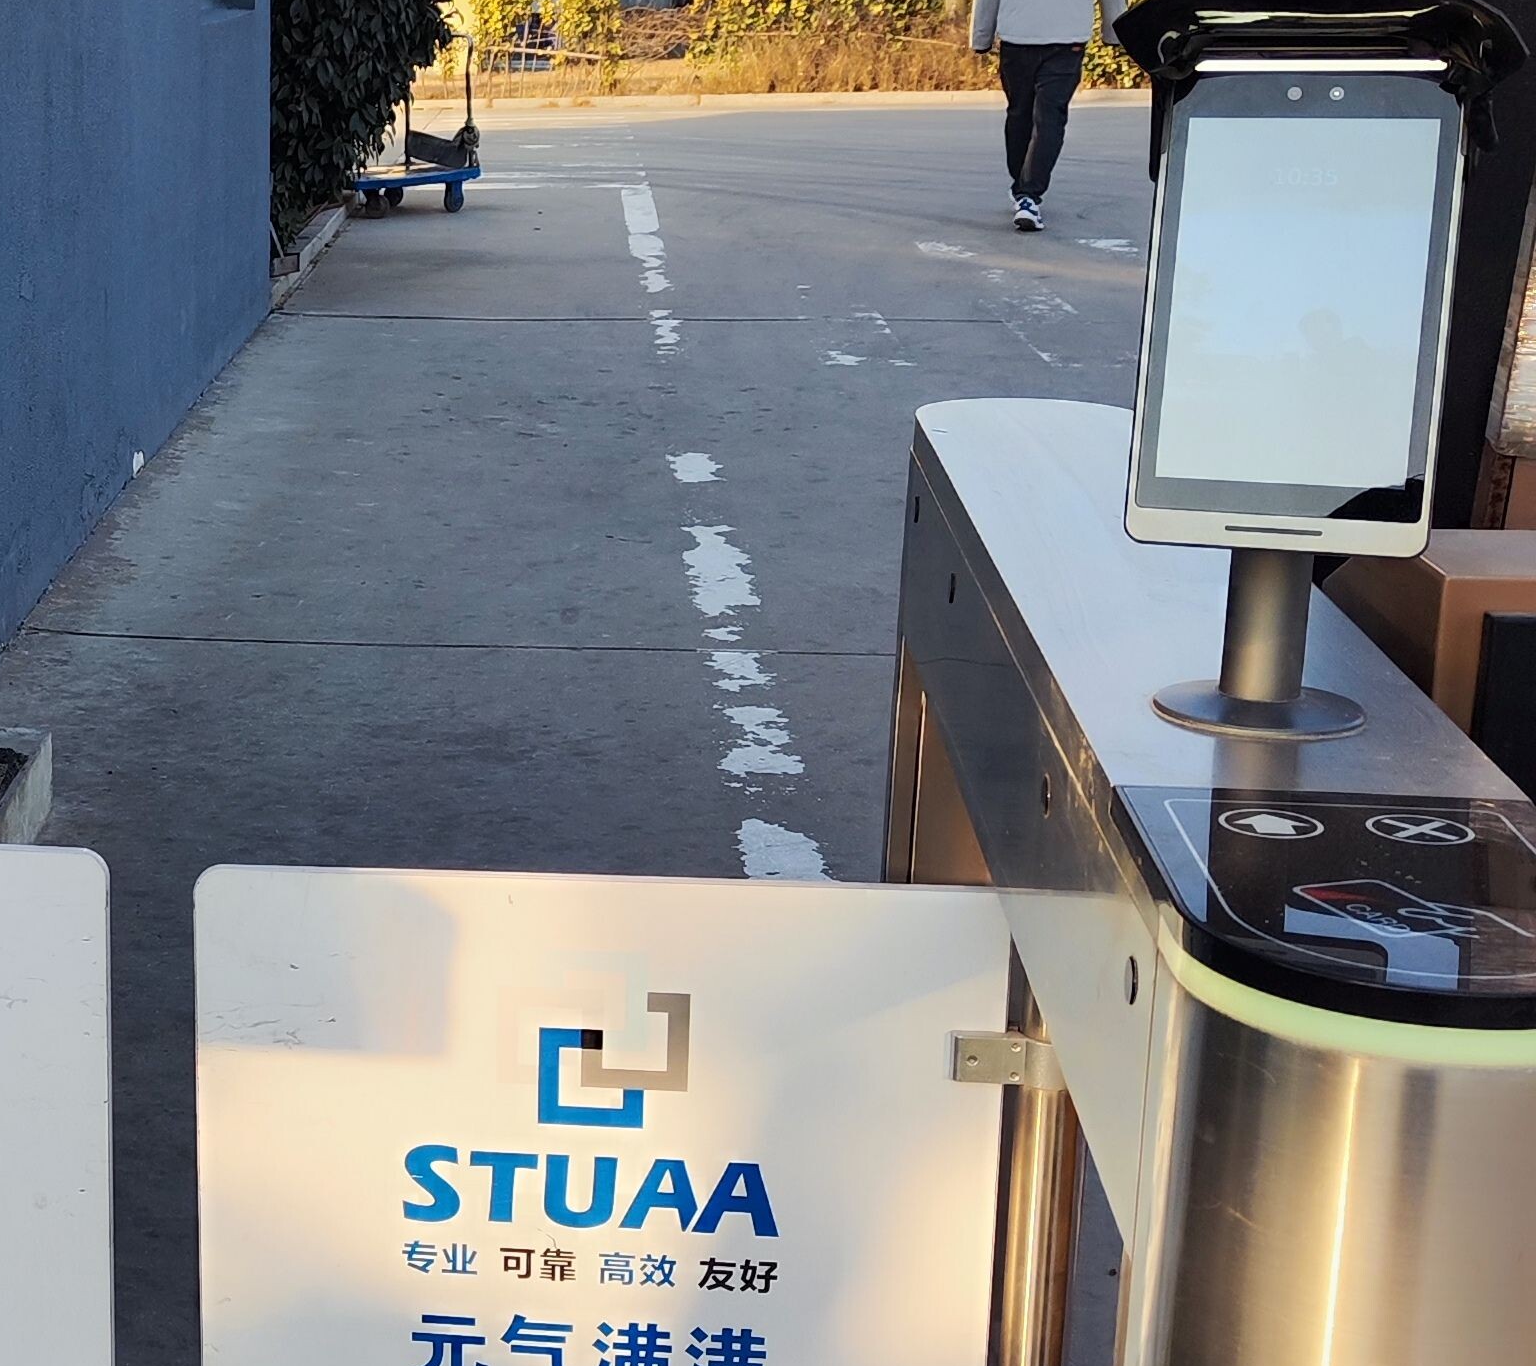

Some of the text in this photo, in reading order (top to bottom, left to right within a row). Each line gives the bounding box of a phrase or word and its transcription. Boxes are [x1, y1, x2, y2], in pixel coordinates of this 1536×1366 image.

[1345, 903, 1410, 932] CARD
[403, 1144, 779, 1237] STUAA
[402, 1240, 778, 1293] 专业 可靠 高效 友好
